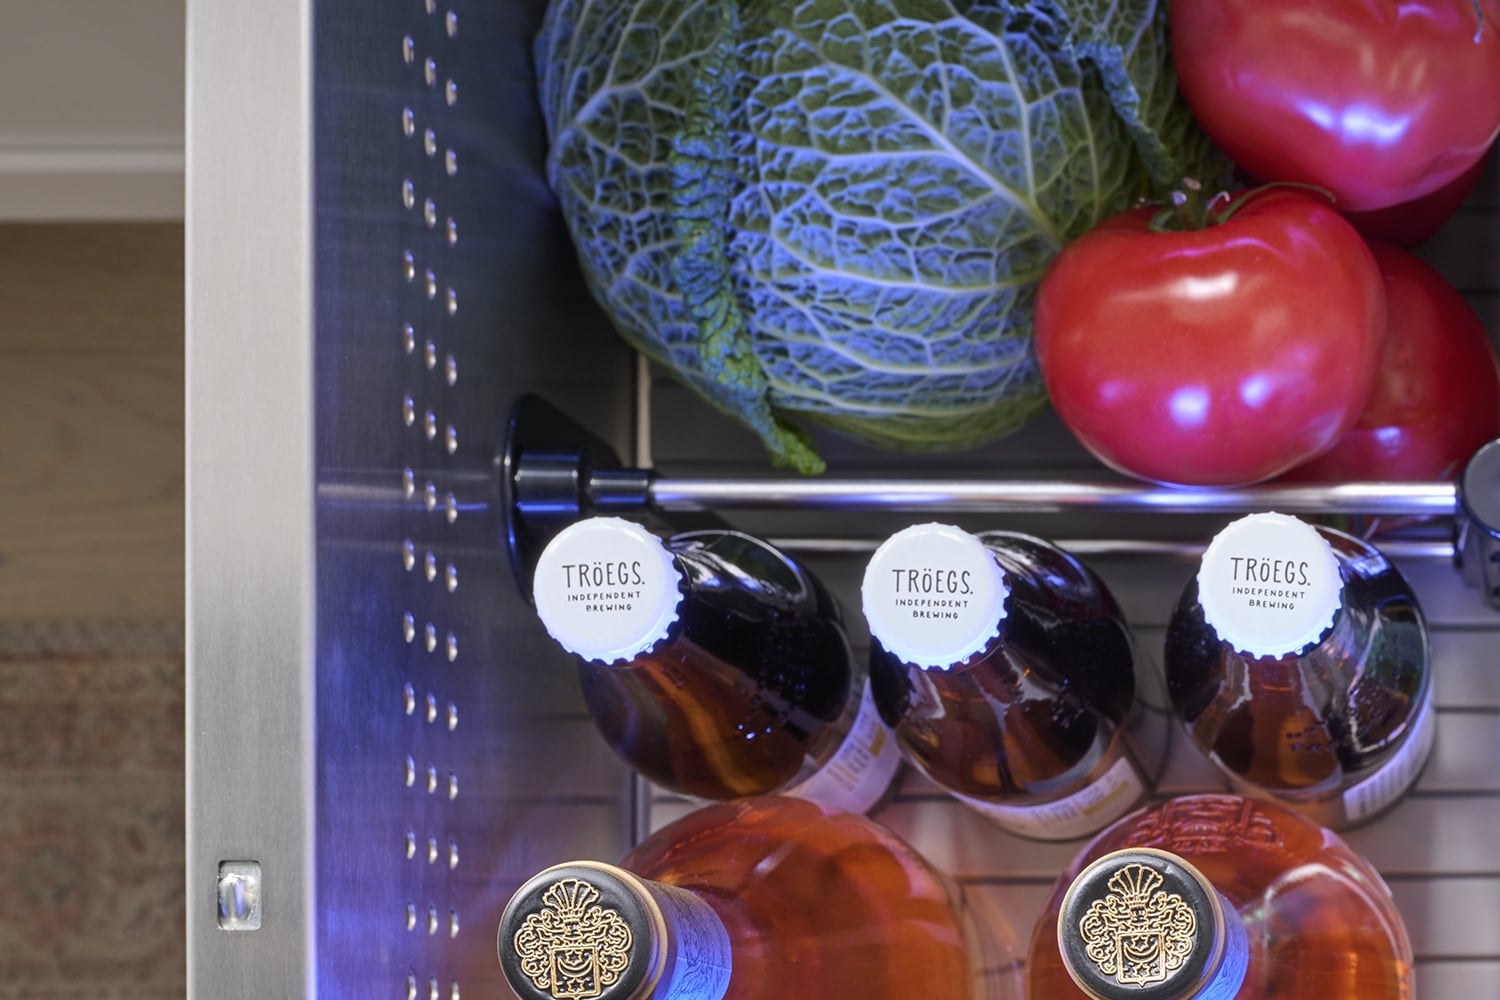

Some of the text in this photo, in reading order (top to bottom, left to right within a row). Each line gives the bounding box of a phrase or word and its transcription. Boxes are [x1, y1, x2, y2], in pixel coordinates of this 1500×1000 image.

[561, 560, 645, 588] TRÖEGS.
[1230, 557, 1311, 586] TRÖEGS.
[891, 568, 974, 595] TRÖEGS.
[567, 591, 641, 602] INDEPENDENT
[1232, 587, 1305, 599] INDEPENDENT
[585, 603, 632, 612] BREWING
[895, 599, 969, 608] INDEPENDENT
[1248, 599, 1295, 610] BREWING
[912, 610, 958, 619] BREWING
